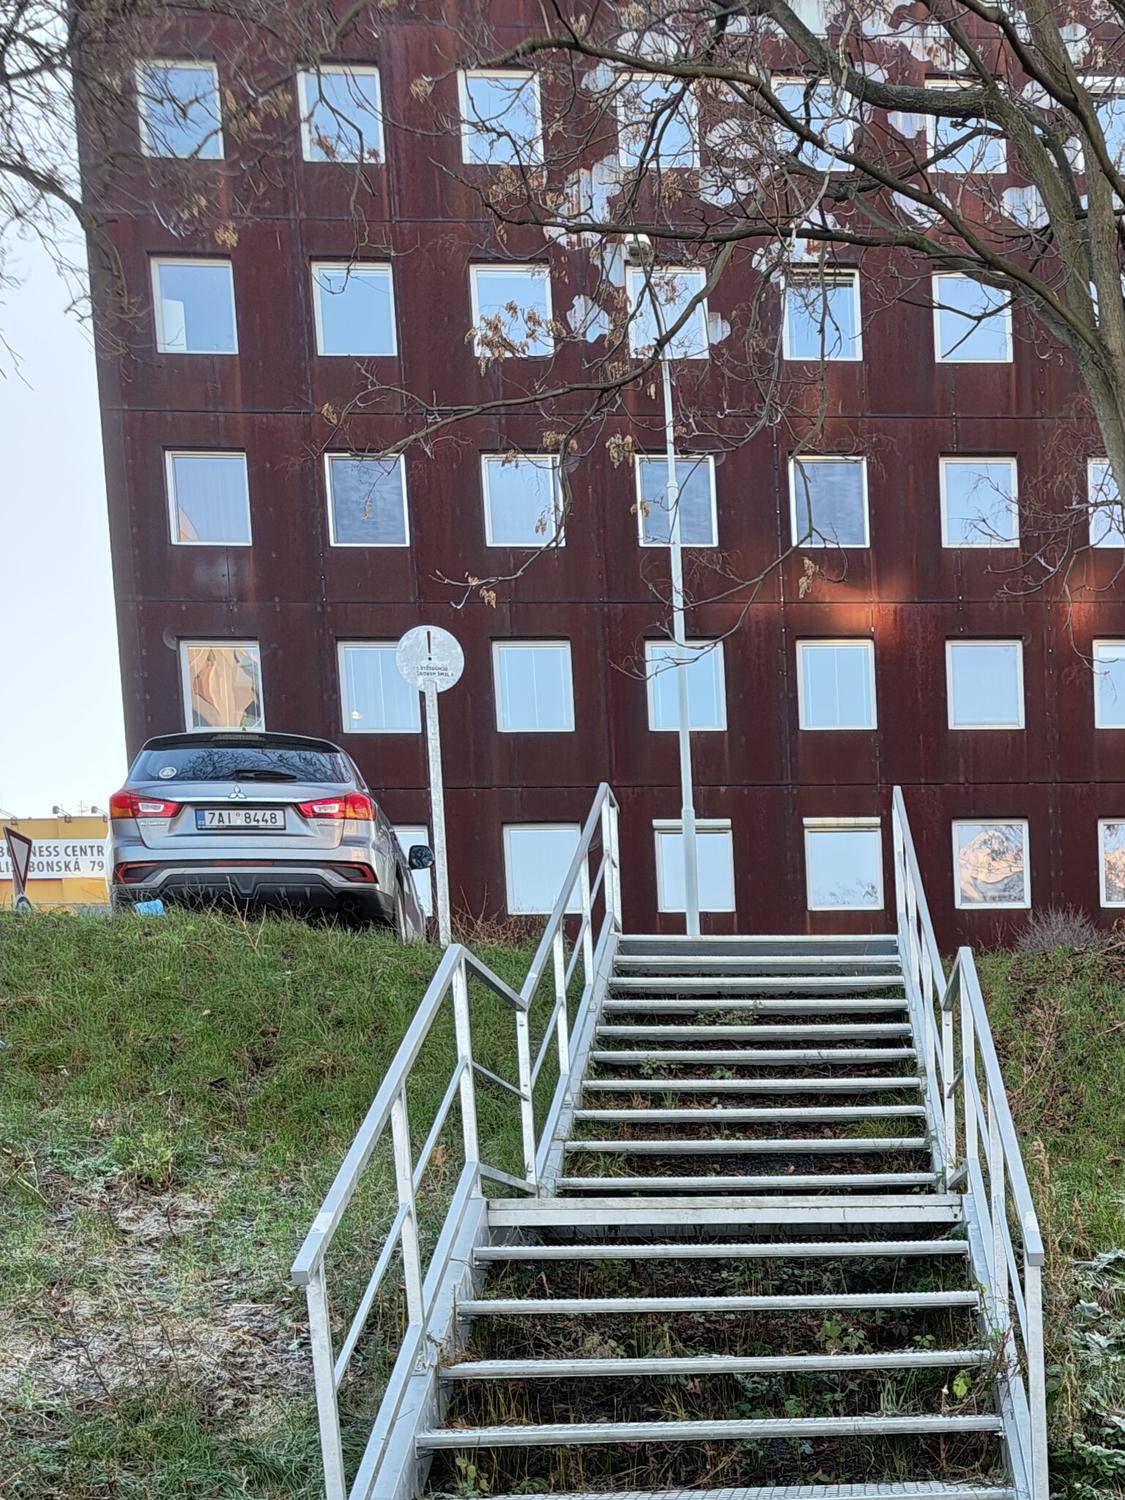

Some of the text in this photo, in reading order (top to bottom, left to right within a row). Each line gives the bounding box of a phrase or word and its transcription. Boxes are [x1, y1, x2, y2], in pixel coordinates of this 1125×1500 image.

[207, 812, 231, 824] 7AI
[244, 812, 277, 825] 8448
[64, 845, 105, 857] CENTR
[89, 860, 105, 872] 79
